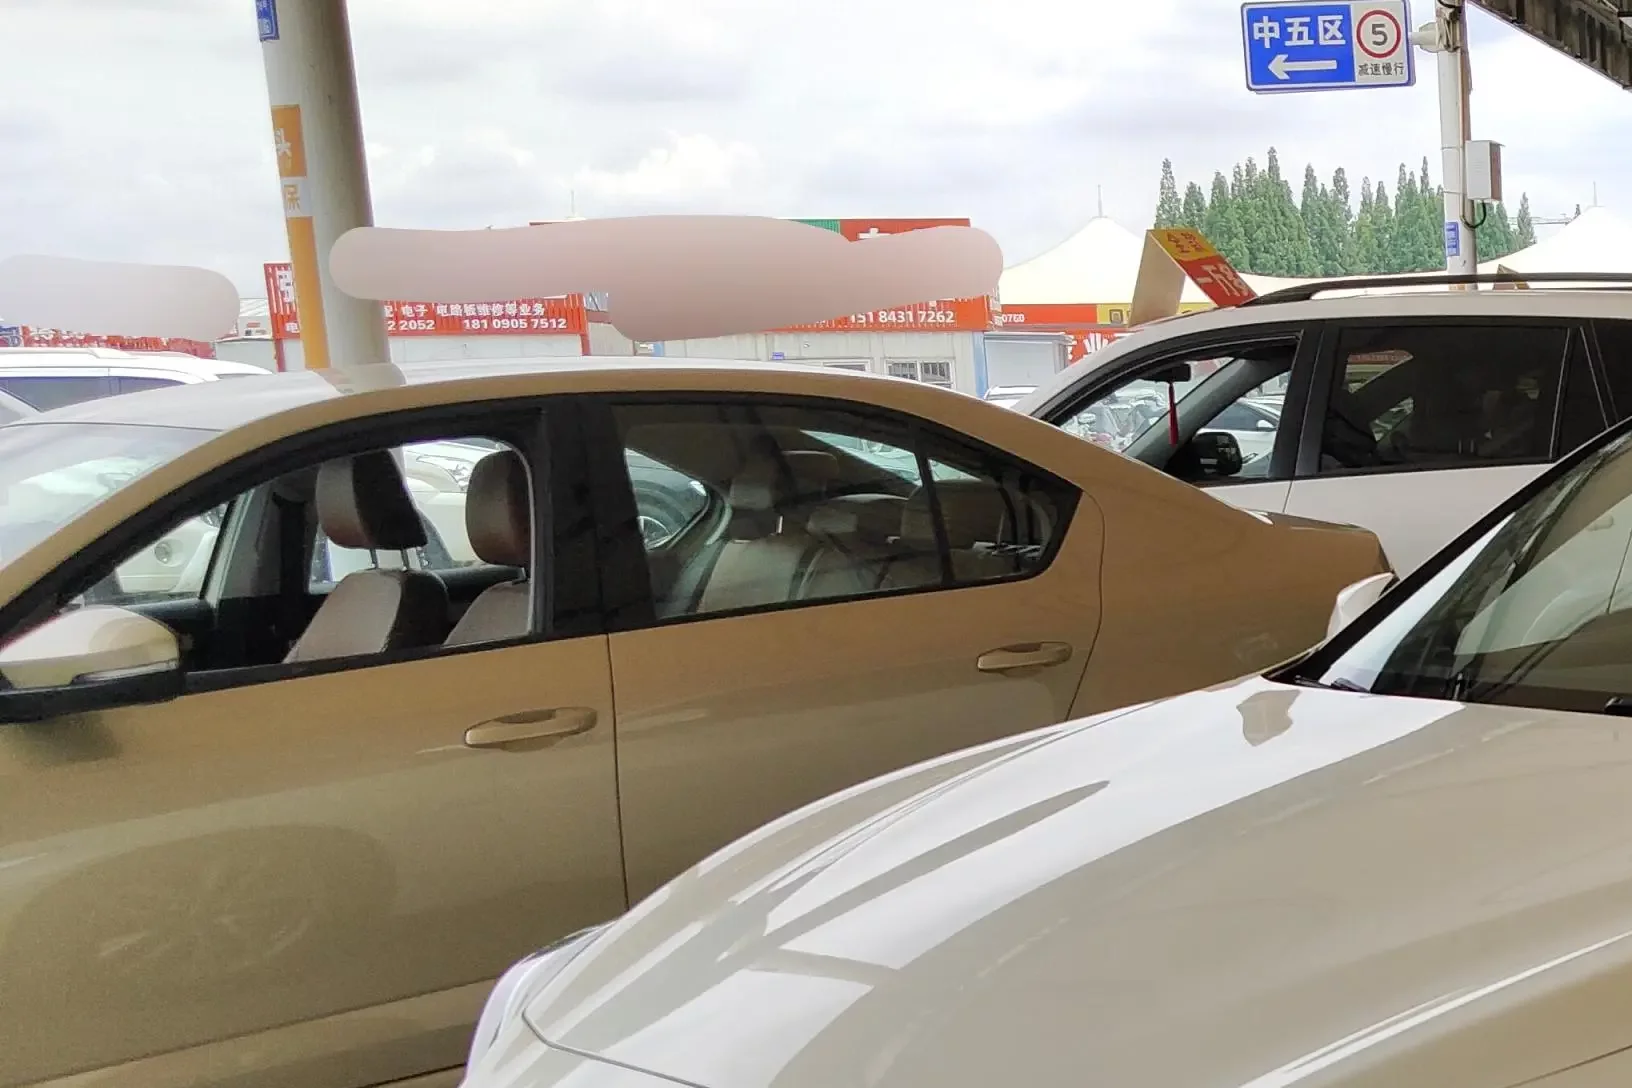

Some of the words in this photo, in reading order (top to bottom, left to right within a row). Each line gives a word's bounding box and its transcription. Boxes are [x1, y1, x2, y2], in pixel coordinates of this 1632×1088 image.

[1252, 15, 1346, 48] 中五区
[1371, 23, 1388, 46] 5
[1358, 62, 1405, 76] 减速慢行
[878, 310, 915, 323] 8431
[918, 310, 955, 323] 7262
[399, 319, 436, 331] 2052
[463, 319, 488, 329] 181
[492, 318, 528, 329] 0905
[531, 317, 567, 329] 7512
